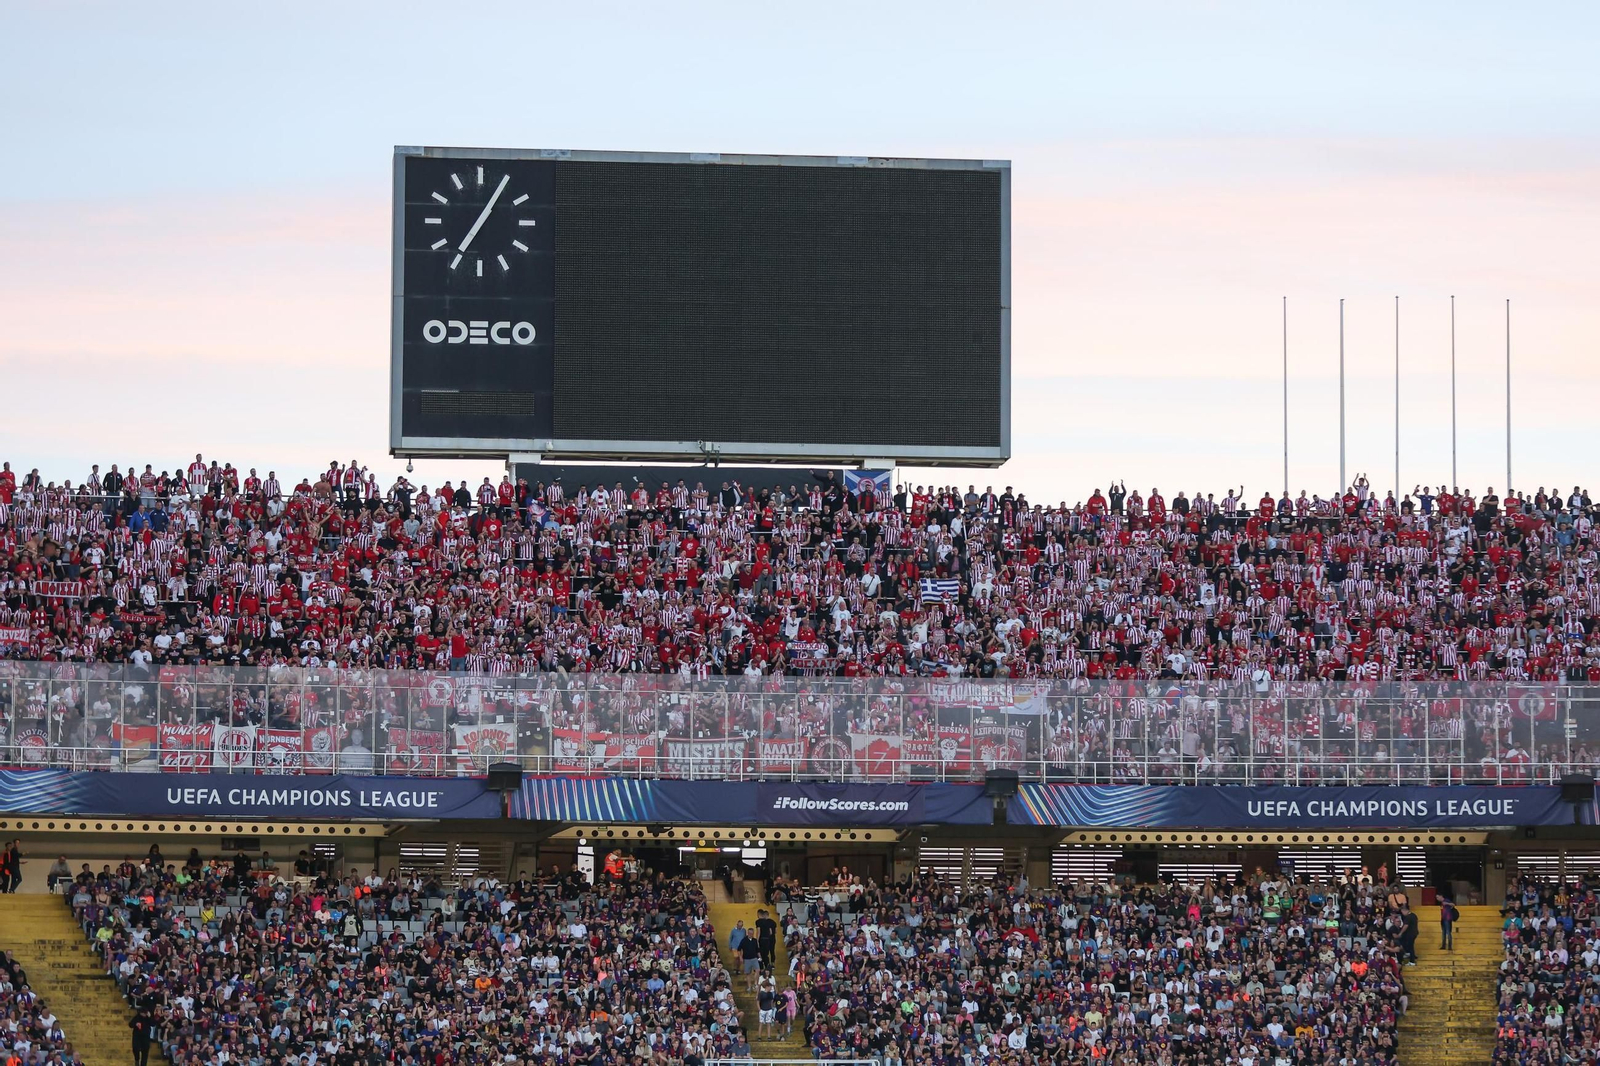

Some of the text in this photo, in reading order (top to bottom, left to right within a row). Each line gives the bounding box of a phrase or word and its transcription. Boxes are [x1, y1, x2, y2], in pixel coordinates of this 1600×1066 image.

[423, 319, 536, 345] ODECO
[930, 725, 970, 734] EEFSINA
[259, 734, 301, 746] NRNBERG
[609, 737, 654, 747] Mschato
[668, 742, 745, 763] MISFITS
[576, 761, 600, 769] COST
[167, 788, 222, 805] UEFA
[228, 788, 351, 806] CHAMPIONS
[781, 797, 909, 811] FollowScores.com
[1247, 800, 1301, 817] UEFA
[1306, 800, 1428, 817] CHAMPIONS
